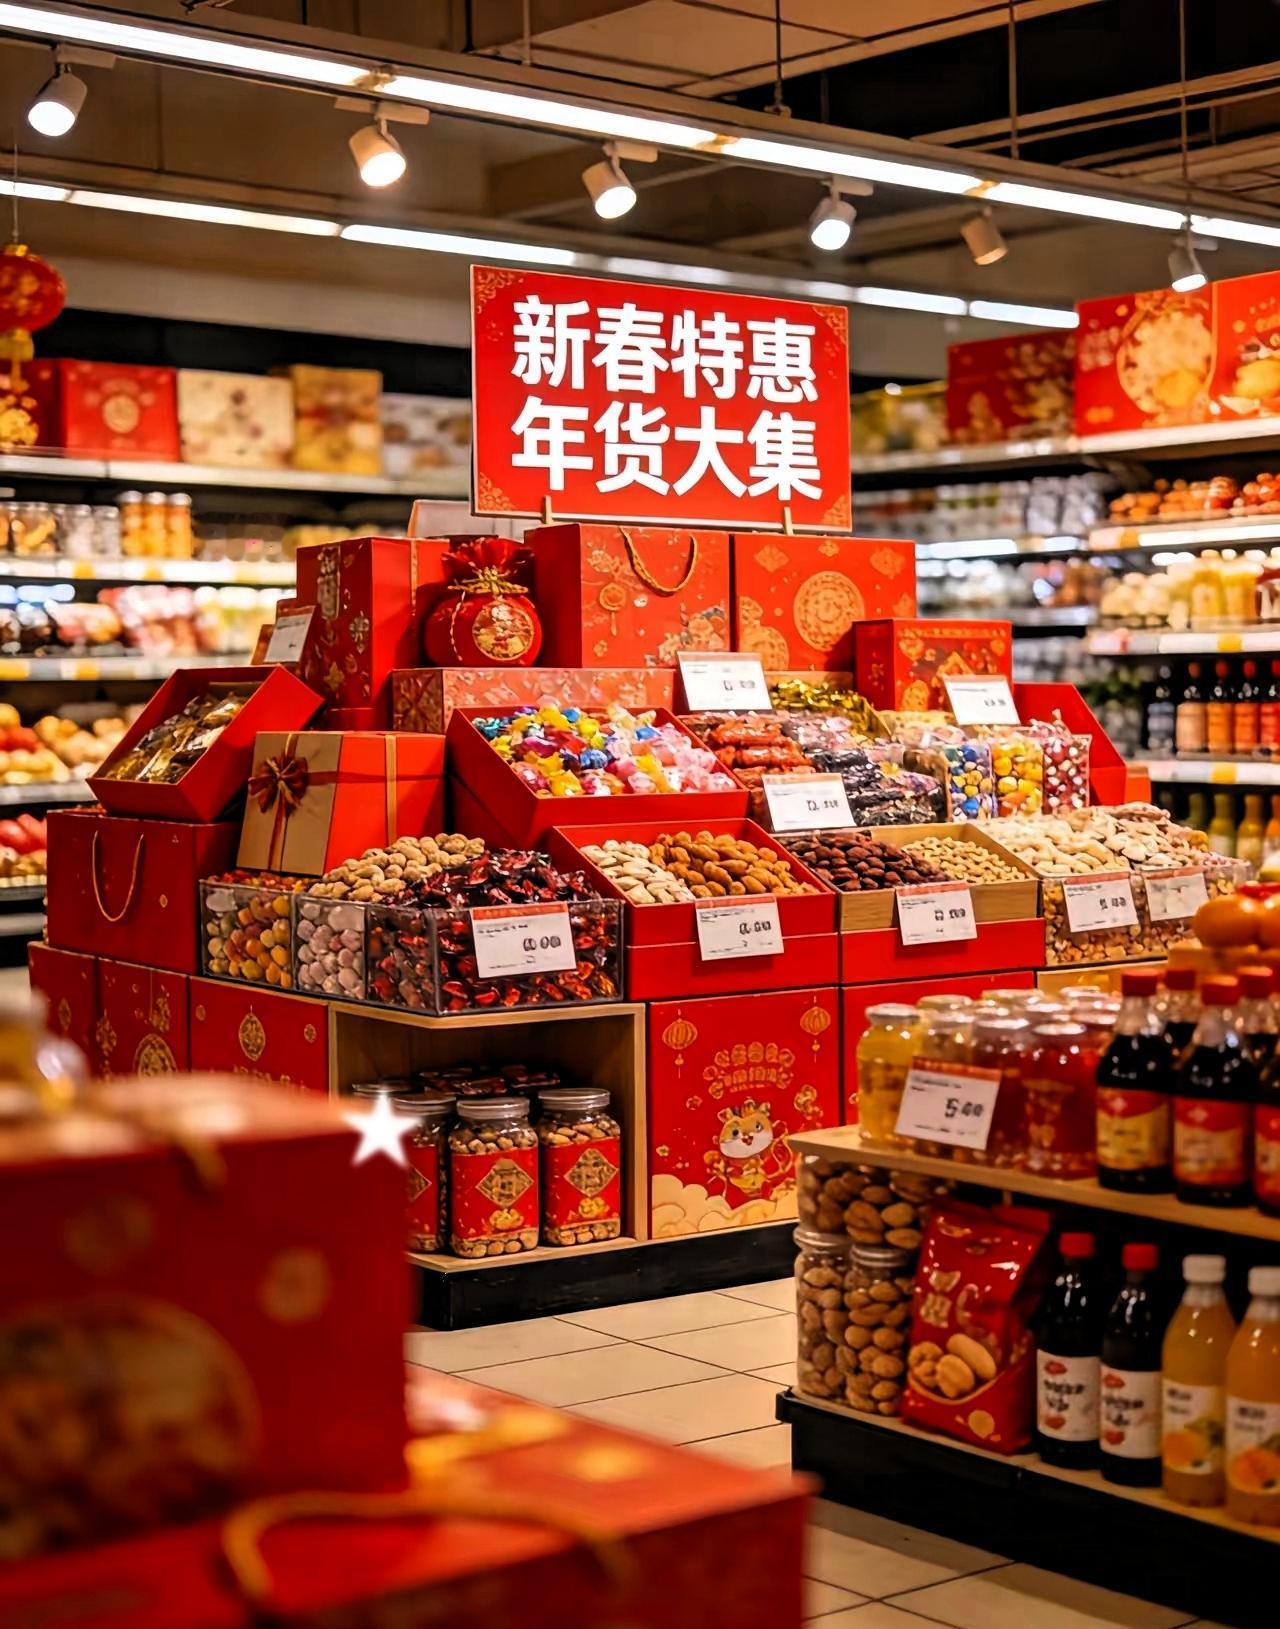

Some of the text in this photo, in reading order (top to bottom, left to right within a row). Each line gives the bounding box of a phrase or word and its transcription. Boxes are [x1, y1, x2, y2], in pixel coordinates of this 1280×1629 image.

[511, 294, 819, 403] 新春特惠
[511, 395, 823, 501] 年货大集
